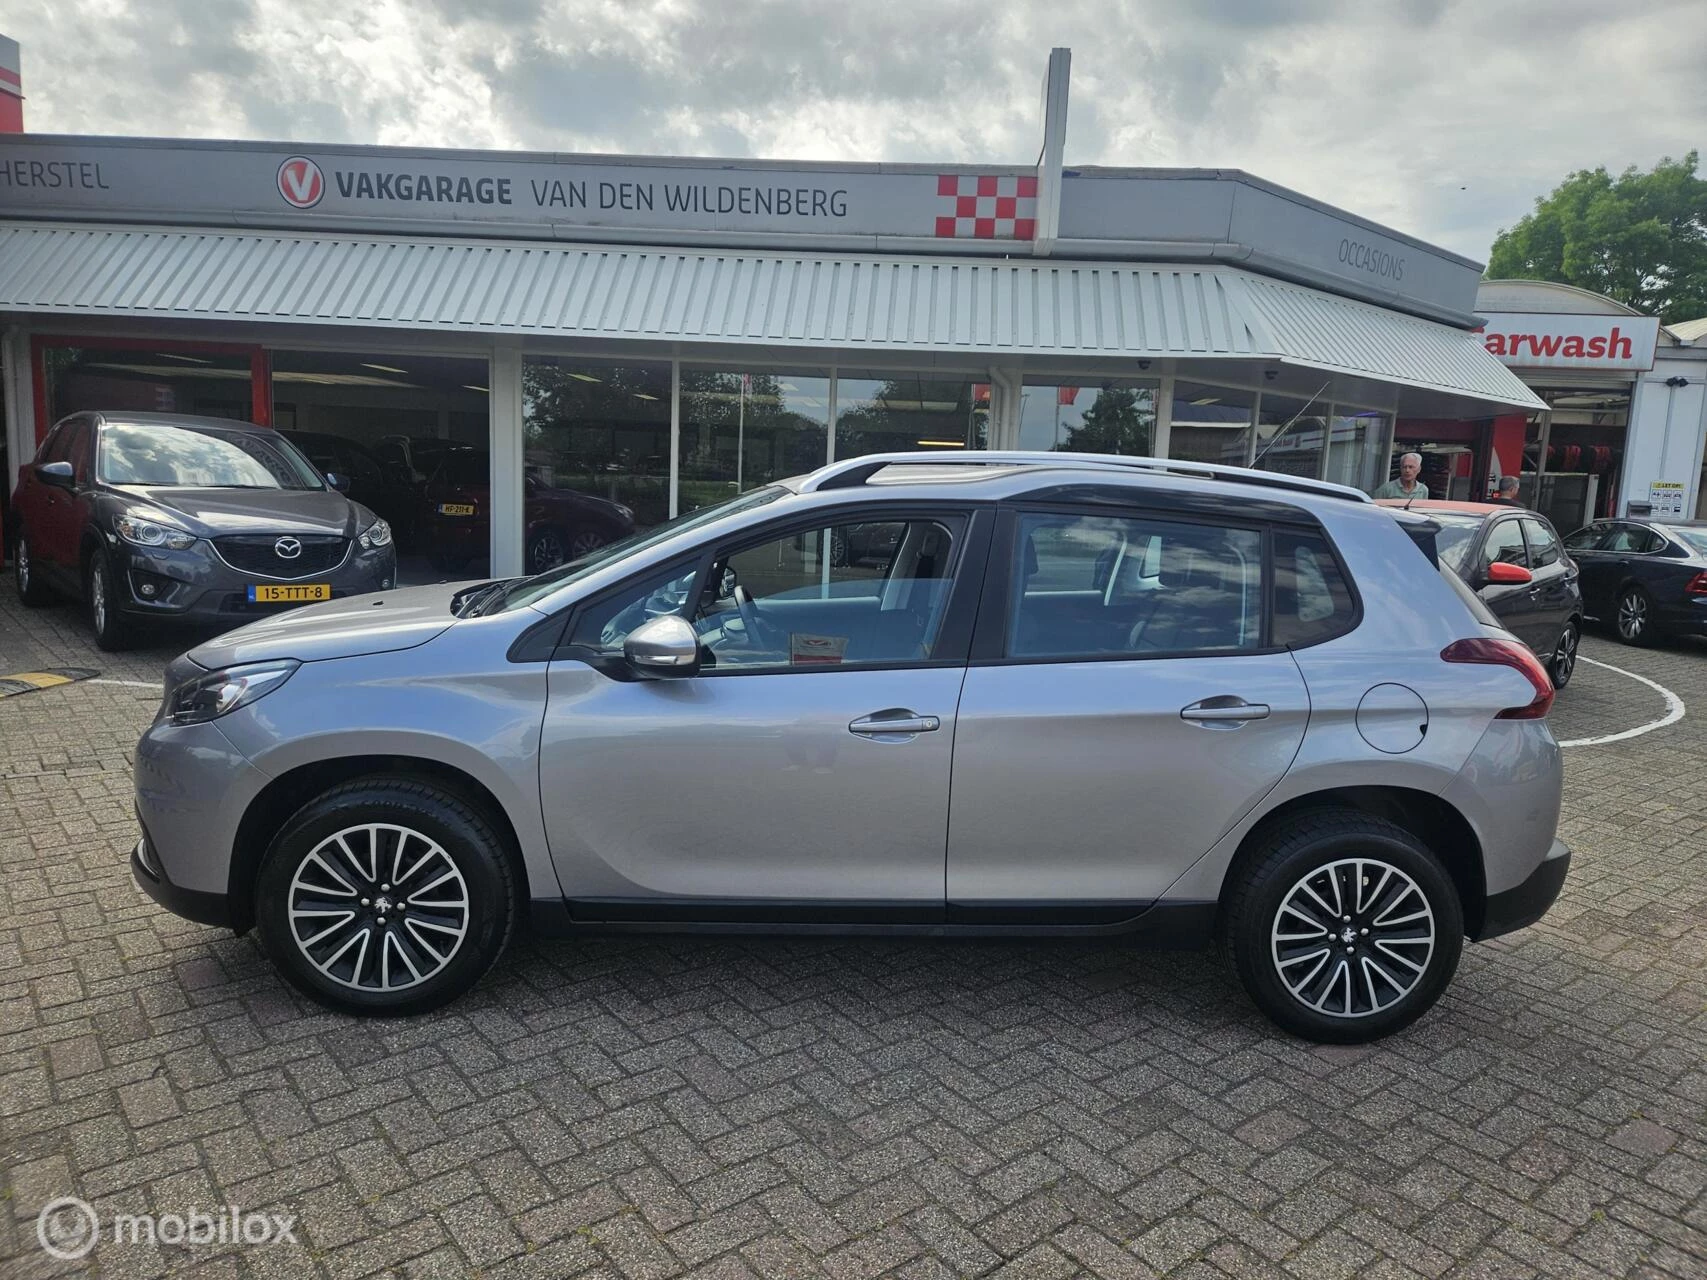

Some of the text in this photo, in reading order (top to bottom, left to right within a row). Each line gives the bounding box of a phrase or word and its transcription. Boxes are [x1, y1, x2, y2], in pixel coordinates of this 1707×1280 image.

[335, 171, 848, 218] VAKGARAGE VAN DEN WILDENBERG
[1339, 239, 1405, 281] OCCASIONS
[1472, 326, 1633, 359] arwash
[265, 587, 322, 600] 15-TTT-8
